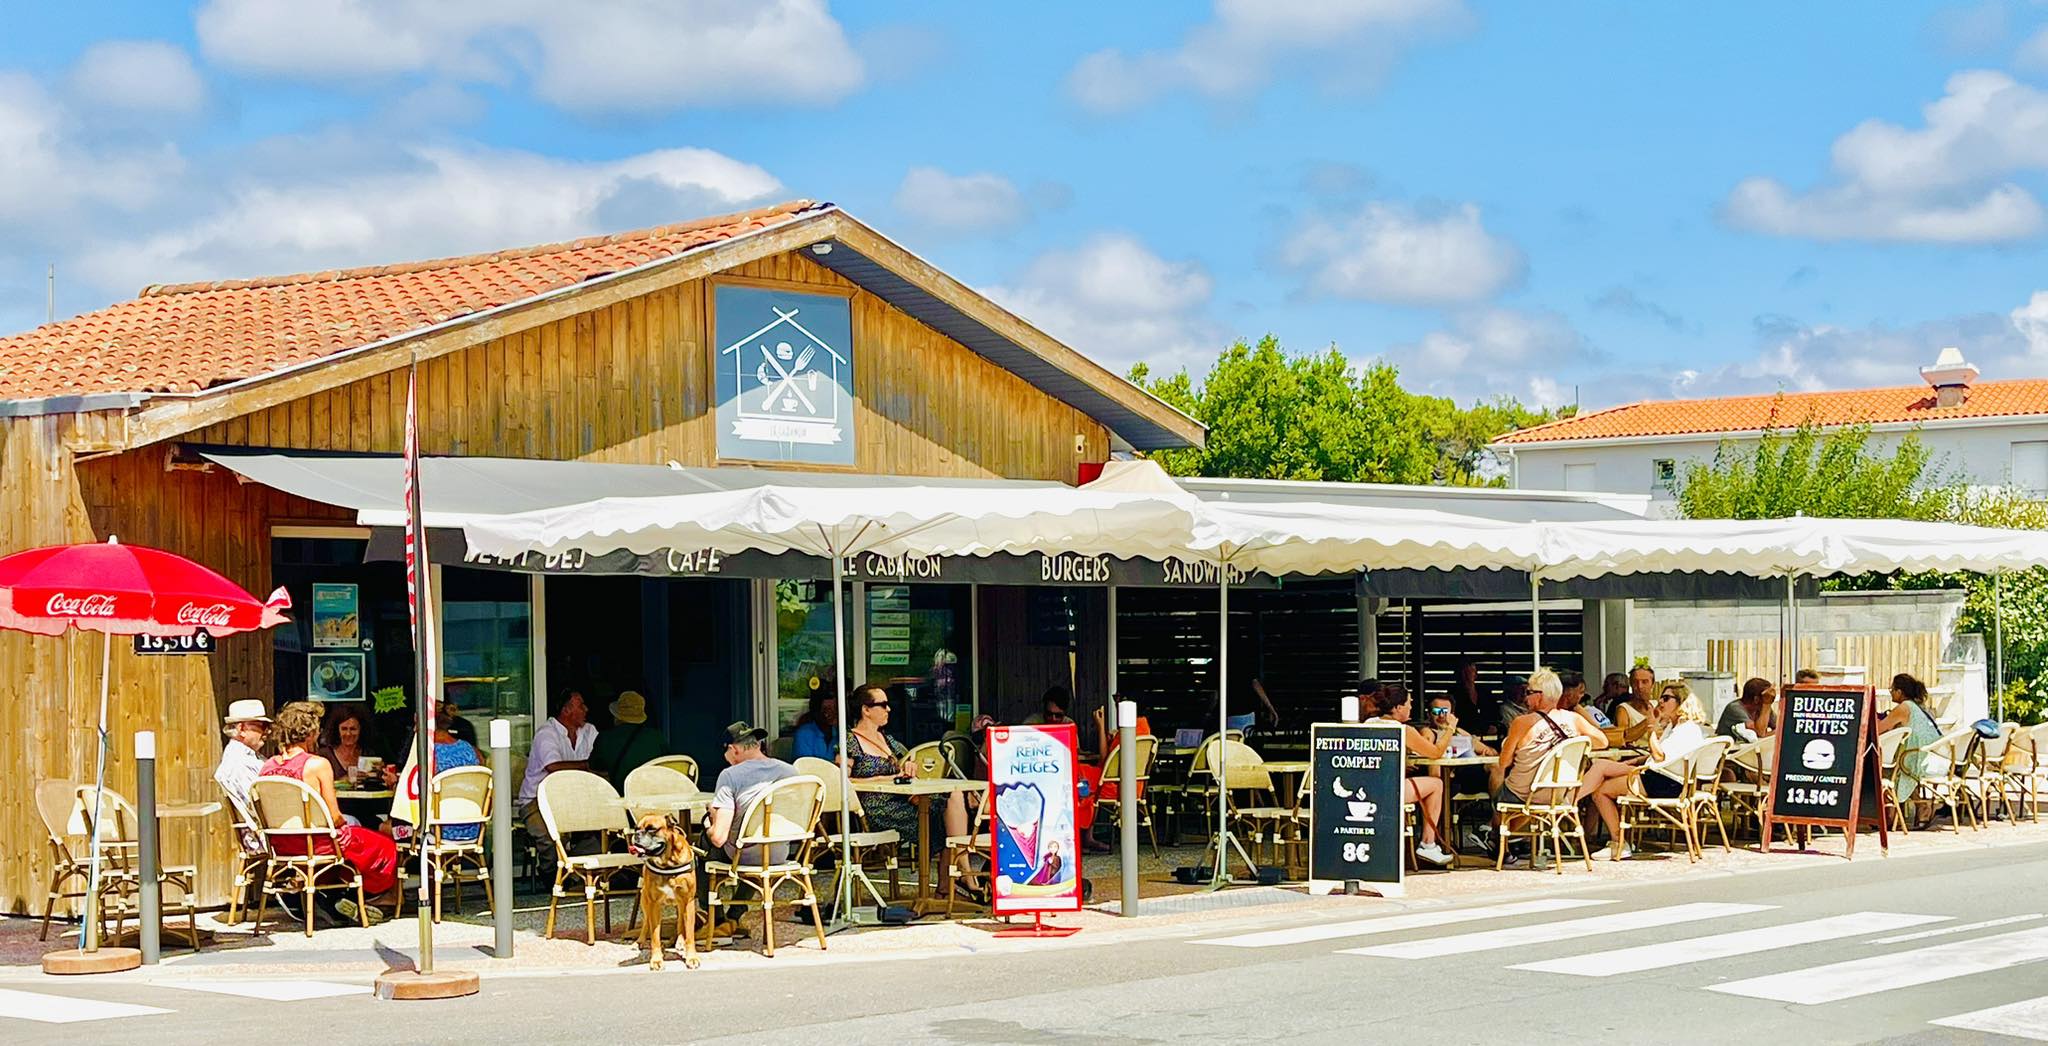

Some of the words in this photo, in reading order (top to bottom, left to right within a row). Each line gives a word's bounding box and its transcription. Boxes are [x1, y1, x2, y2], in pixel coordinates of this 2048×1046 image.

[841, 556, 858, 577] LE
[865, 554, 941, 578] CABANON
[1041, 555, 1111, 582] BURGERS
[1162, 558, 1246, 584] SANDWIHS
[46, 592, 118, 617] Coca-Cola
[177, 601, 235, 627] Coca-Cola
[1793, 697, 1855, 713] BURGER
[1795, 719, 1849, 735] FRITES
[1016, 744, 1053, 757] REINE
[1316, 738, 1345, 751] PETIT
[1346, 738, 1399, 752] DEJEUNER
[1010, 760, 1059, 775] NEIGES
[1331, 756, 1381, 769] COMPLET
[1786, 788, 1839, 806] 13.50€
[1333, 826, 1340, 834] A
[1340, 827, 1364, 835] PARTIR
[1343, 843, 1370, 863] 8€
